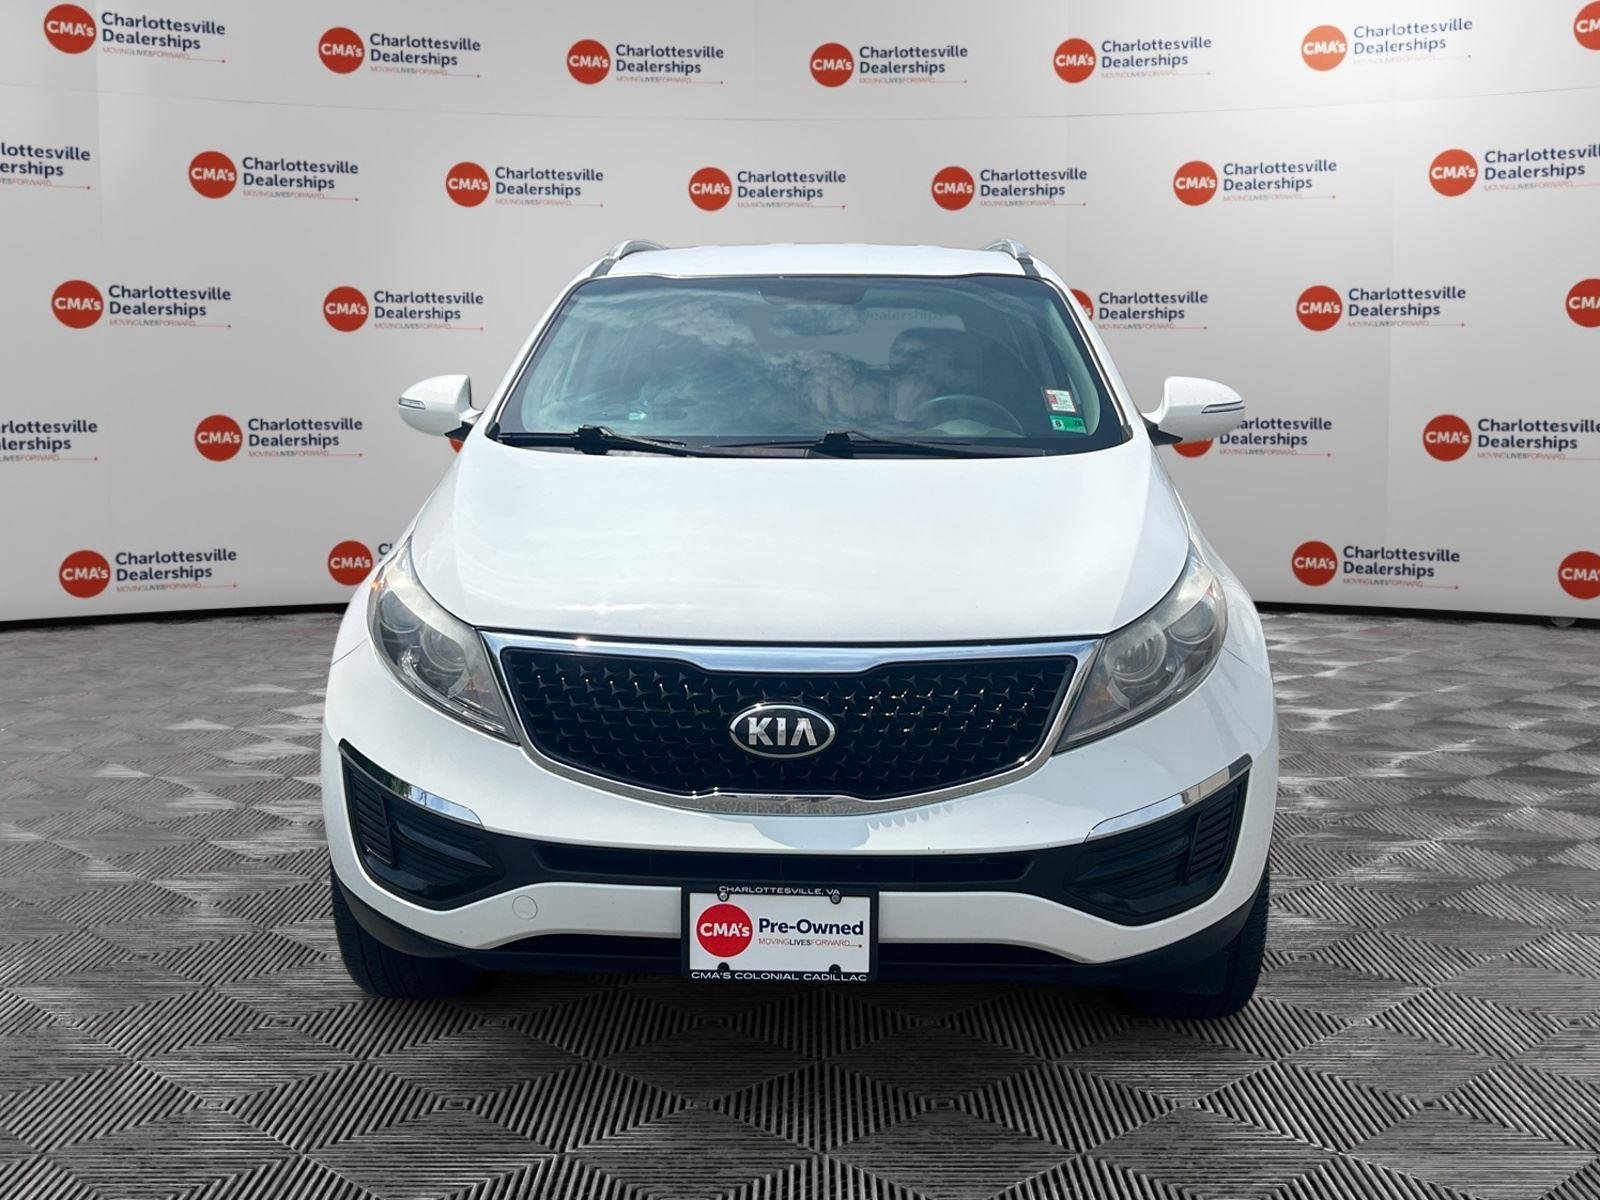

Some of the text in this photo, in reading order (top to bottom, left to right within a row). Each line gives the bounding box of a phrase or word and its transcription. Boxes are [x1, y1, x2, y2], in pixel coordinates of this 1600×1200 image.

[46, 20, 94, 37] CMA's
[101, 12, 225, 35] Charlottesville
[1354, 18, 1472, 38] Charlottesville
[102, 28, 200, 52] Dealerships
[370, 33, 480, 51] Charlottesville
[1101, 36, 1211, 53] Charlottesville
[1303, 40, 1347, 54] CMA's
[1354, 38, 1446, 54] Dealerships
[321, 43, 362, 57] CMA's
[616, 44, 724, 58] Charlottesville
[859, 45, 968, 58] Charlottesville
[370, 49, 458, 68] Dealerships
[569, 55, 608, 68] CMA's
[812, 59, 852, 70] CMA's
[1055, 54, 1095, 67] CMA's
[1102, 54, 1188, 68] Dealerships
[616, 59, 701, 76] Dealerships
[860, 61, 945, 76] Dealerships
[1, 142, 90, 161] lottesville
[0, 161, 64, 179] erships
[242, 156, 358, 174] Charlottesville
[1223, 160, 1336, 176] Charlottesville
[1431, 165, 1477, 179] CMA's
[1485, 163, 1585, 180] Dealerships
[191, 167, 236, 182] CMA's
[495, 166, 603, 181] Charlottesville
[737, 170, 846, 183] Charlottesville
[980, 168, 1087, 182] Charlottesville
[243, 172, 335, 192] Dealerships
[448, 178, 488, 190] CMA's
[691, 183, 730, 195] CMA's
[934, 182, 973, 194] CMA's
[1175, 176, 1216, 189] CMA's
[1223, 176, 1312, 192] Dealerships
[496, 182, 581, 199] Dealerships
[738, 186, 823, 201] Dealerships
[980, 184, 1065, 199] Dealerships
[108, 285, 231, 300] Charlottesville
[374, 290, 483, 304] Charlottesville
[1099, 291, 1208, 304] Charlottesville
[1348, 286, 1466, 301] Charlottesville
[54, 297, 101, 310] CMA's
[110, 301, 206, 319] Dealerships
[325, 303, 367, 315] CMA's
[1299, 302, 1340, 314] CMA's
[1348, 303, 1440, 319] Dealerships
[374, 306, 461, 322] Dealerships
[1099, 307, 1184, 322] Dealerships
[2, 420, 98, 434] rlottesville
[248, 418, 362, 431] Charlottesville
[1236, 417, 1332, 430] arlottesville
[1478, 418, 1600, 433] Charlottesville
[0, 436, 71, 453] lerships
[197, 432, 240, 444] CMA's
[249, 433, 339, 449] Dealerships
[1219, 431, 1308, 448] Dealerships
[1425, 432, 1469, 444] CMA's
[1478, 434, 1577, 452] Dealerships
[115, 548, 236, 566] Charlottesville
[1343, 546, 1460, 562] Charlottesville
[330, 556, 371, 569] CMA's
[1294, 557, 1335, 570] CMA's
[1344, 561, 1434, 578] Dealerships
[62, 567, 108, 580] CMA's
[116, 565, 212, 581] Dealerships
[1561, 568, 1600, 581] CMA'
[748, 717, 817, 746] KIA
[719, 886, 823, 895] CHARLOTTESVILLE,
[700, 922, 750, 937] CMA's
[758, 918, 864, 935] Pre-Owned
[691, 972, 867, 982] CMA'S COLONIAL CADILLAC
